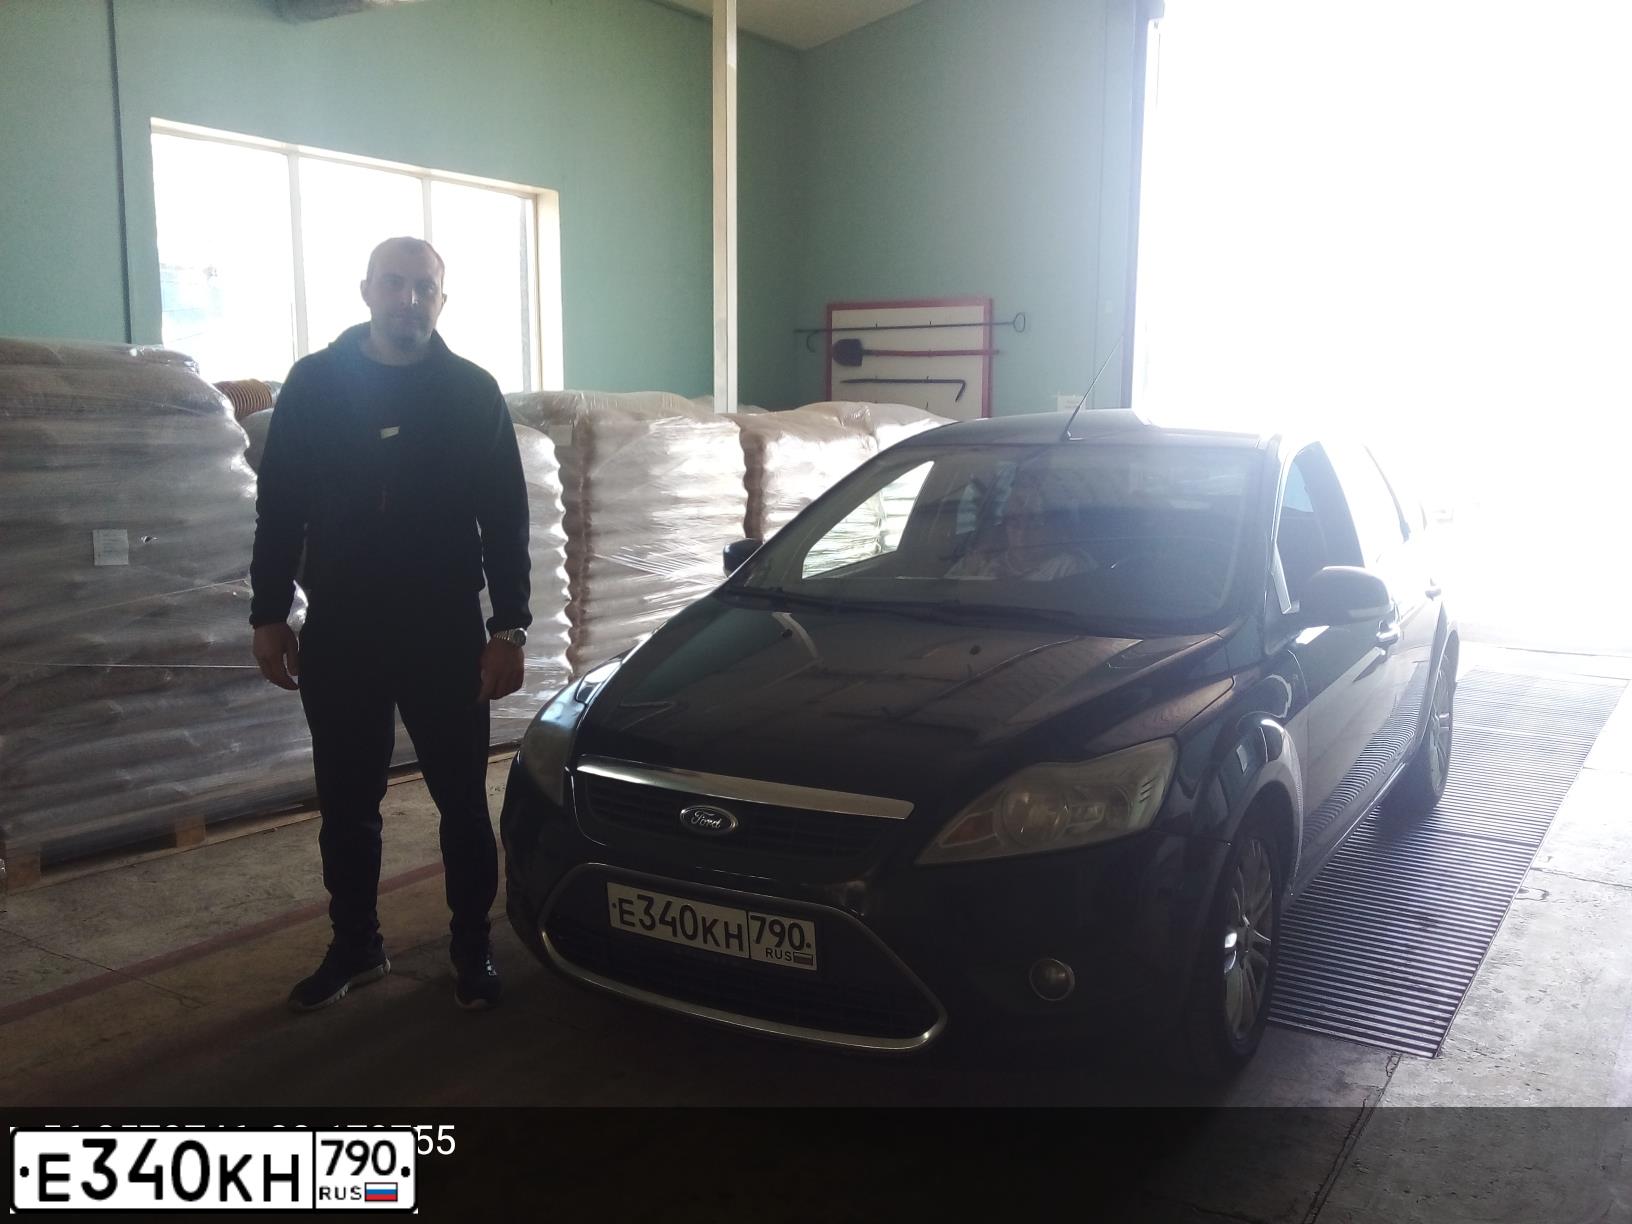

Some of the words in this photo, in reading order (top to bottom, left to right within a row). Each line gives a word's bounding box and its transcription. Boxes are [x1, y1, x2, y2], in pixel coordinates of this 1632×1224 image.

[690, 810, 722, 829] Ford
[750, 915, 806, 951] 790
[765, 947, 792, 962] RUS
